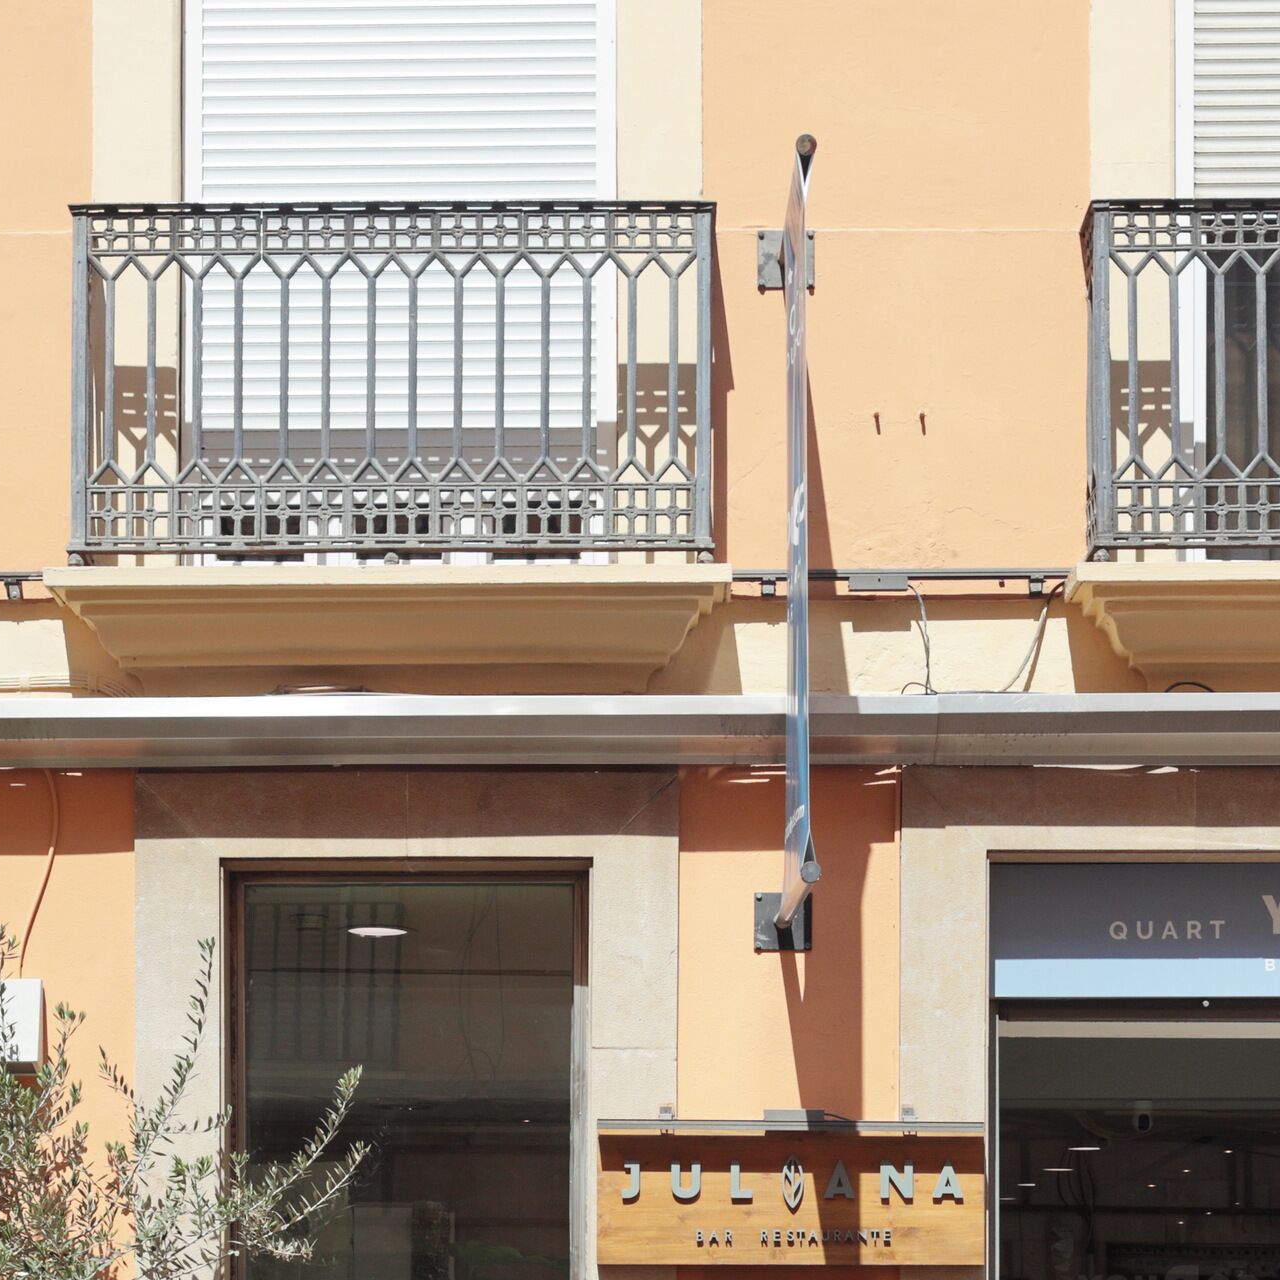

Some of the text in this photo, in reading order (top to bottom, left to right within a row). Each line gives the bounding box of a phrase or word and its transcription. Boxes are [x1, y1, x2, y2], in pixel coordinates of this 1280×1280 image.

[1109, 920, 1227, 941] QUART
[695, 1230, 893, 1247] BAR RESTAURANTE
